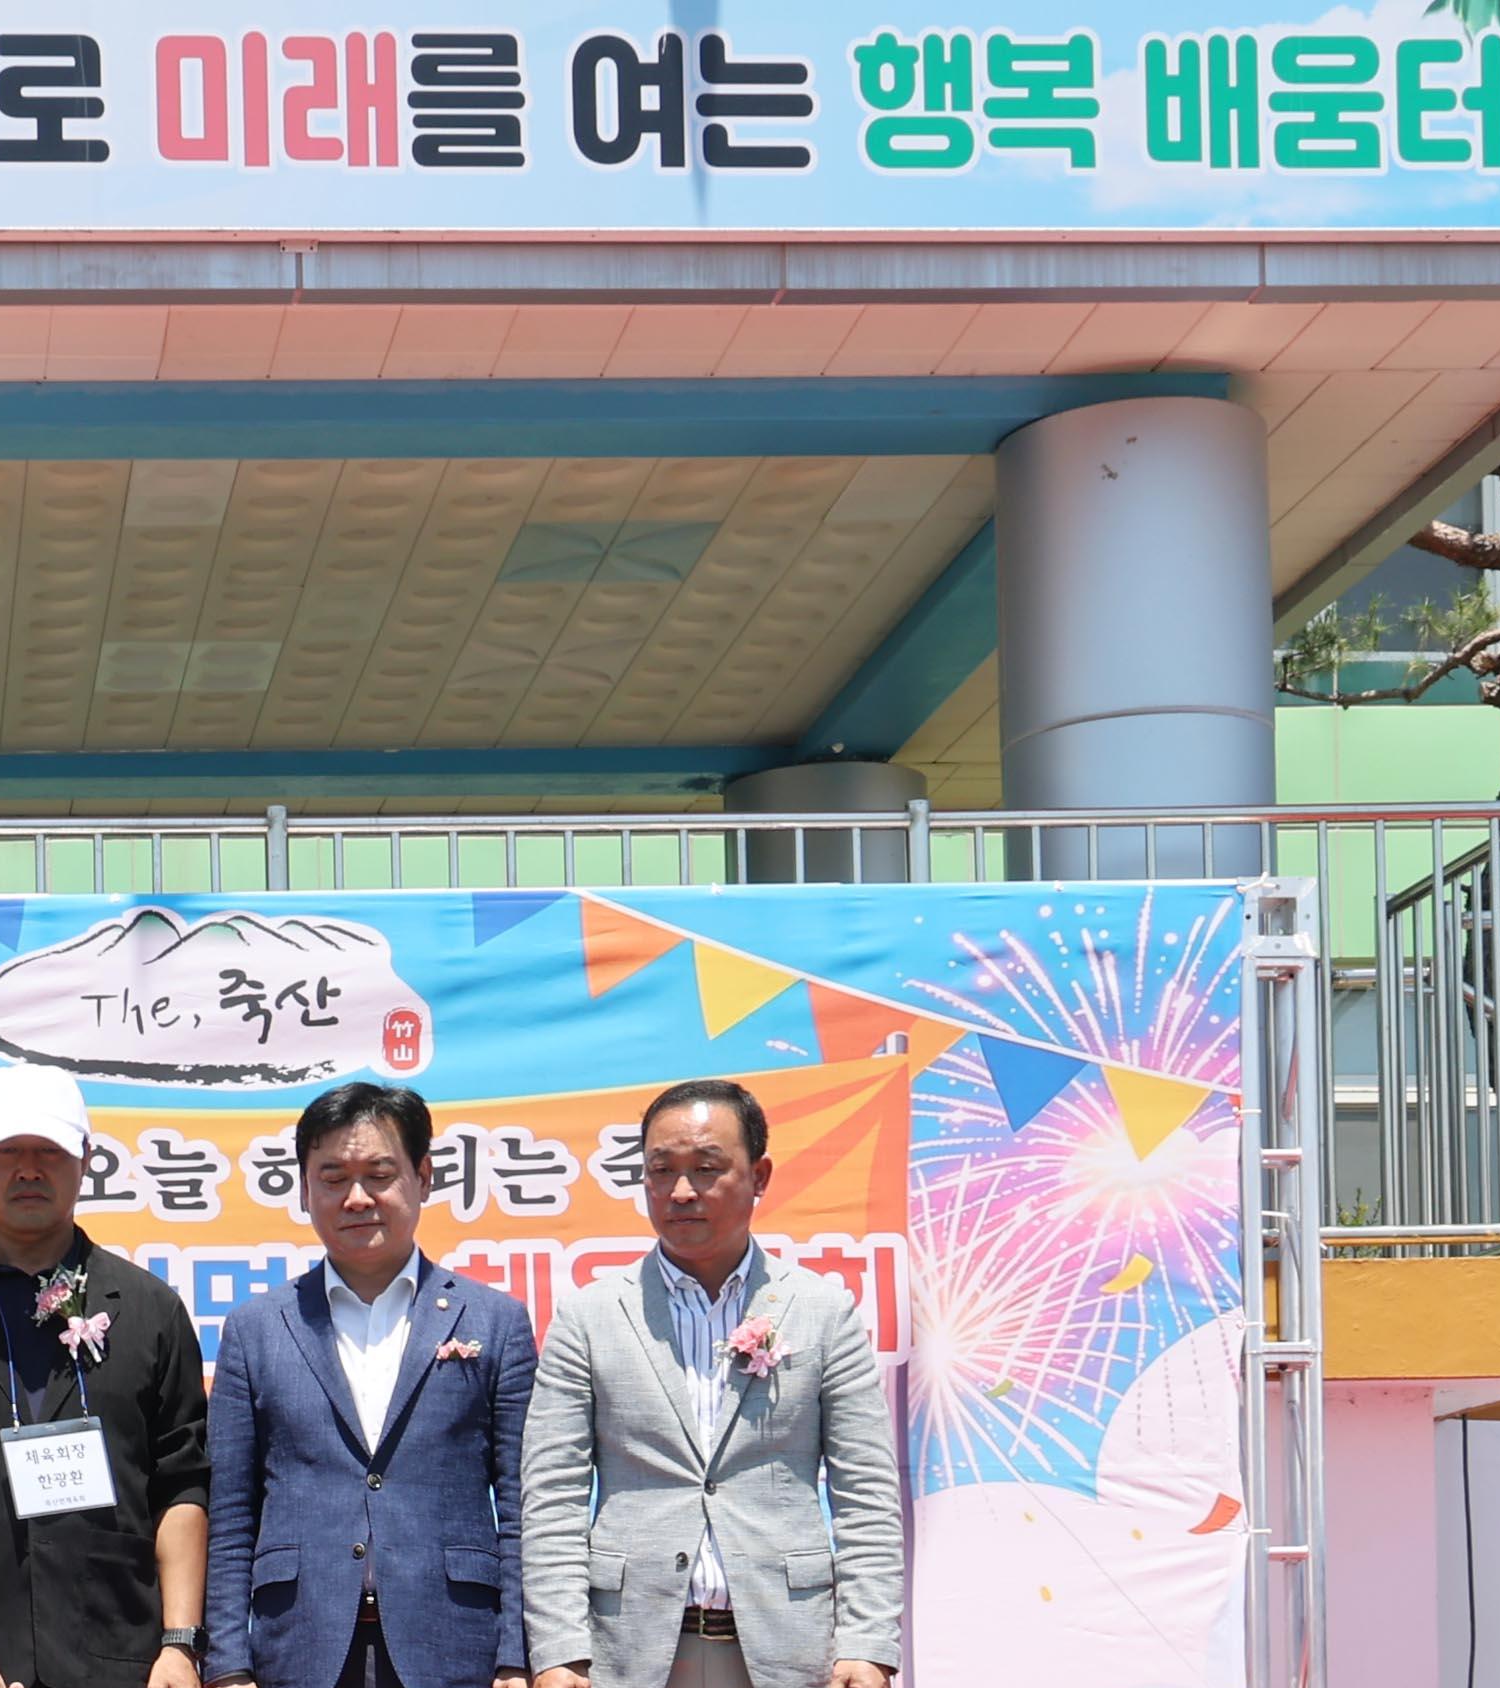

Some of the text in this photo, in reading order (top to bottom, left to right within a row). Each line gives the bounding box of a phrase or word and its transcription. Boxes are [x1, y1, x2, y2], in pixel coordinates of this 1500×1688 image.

[154, 28, 527, 169] 미래를
[568, 30, 815, 170] 여는
[852, 29, 1101, 171] 행복
[81, 968, 342, 1044] The, 죽산
[25, 1443, 85, 1465] 체육회장
